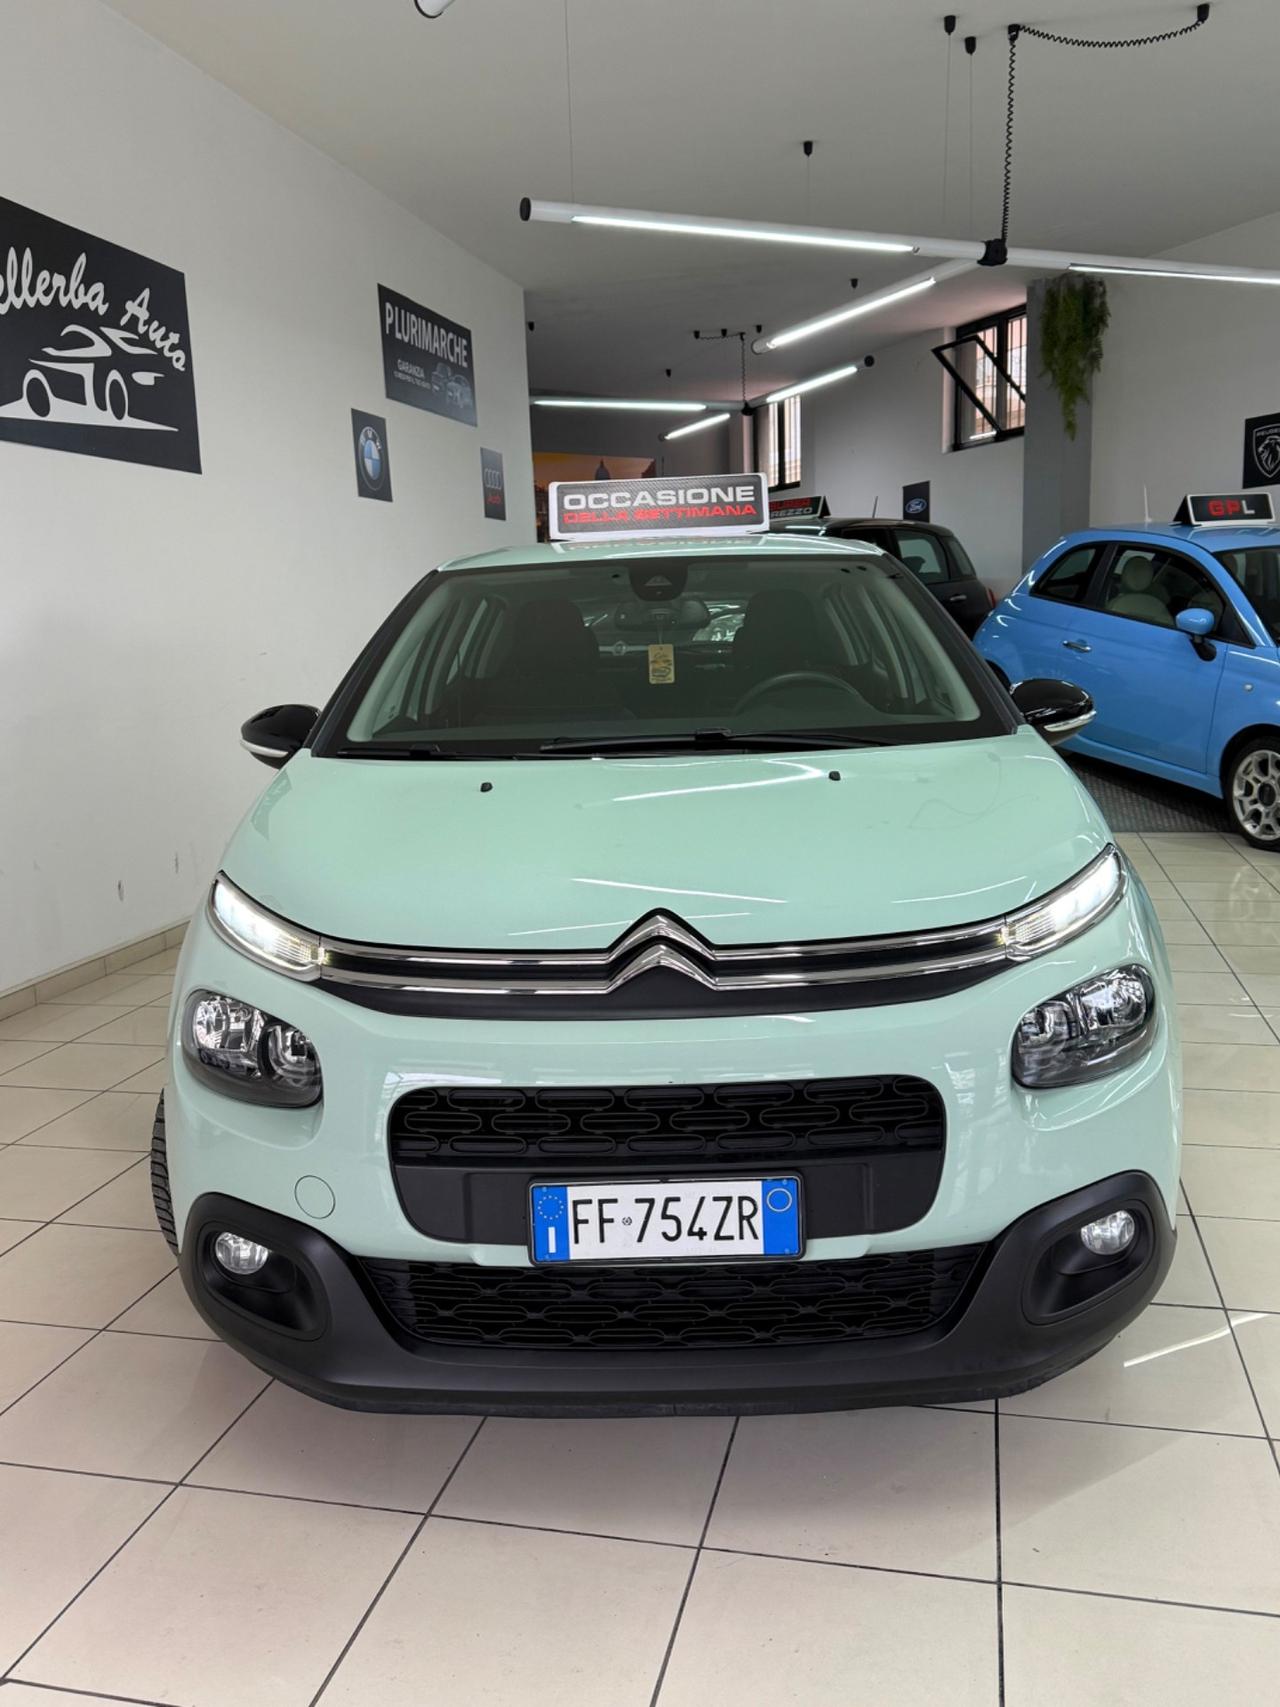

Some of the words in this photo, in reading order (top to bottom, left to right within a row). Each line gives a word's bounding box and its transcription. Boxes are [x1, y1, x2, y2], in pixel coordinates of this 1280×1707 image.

[120, 287, 186, 371] Auto
[385, 302, 468, 368] PLURIMARCHE
[563, 485, 755, 510] OCCASIONE
[563, 511, 629, 524] DELLA
[634, 504, 757, 522] SETTIMANA
[1208, 499, 1256, 517] GPL
[572, 1198, 618, 1244] FF
[635, 1196, 760, 1243] 754ZR
